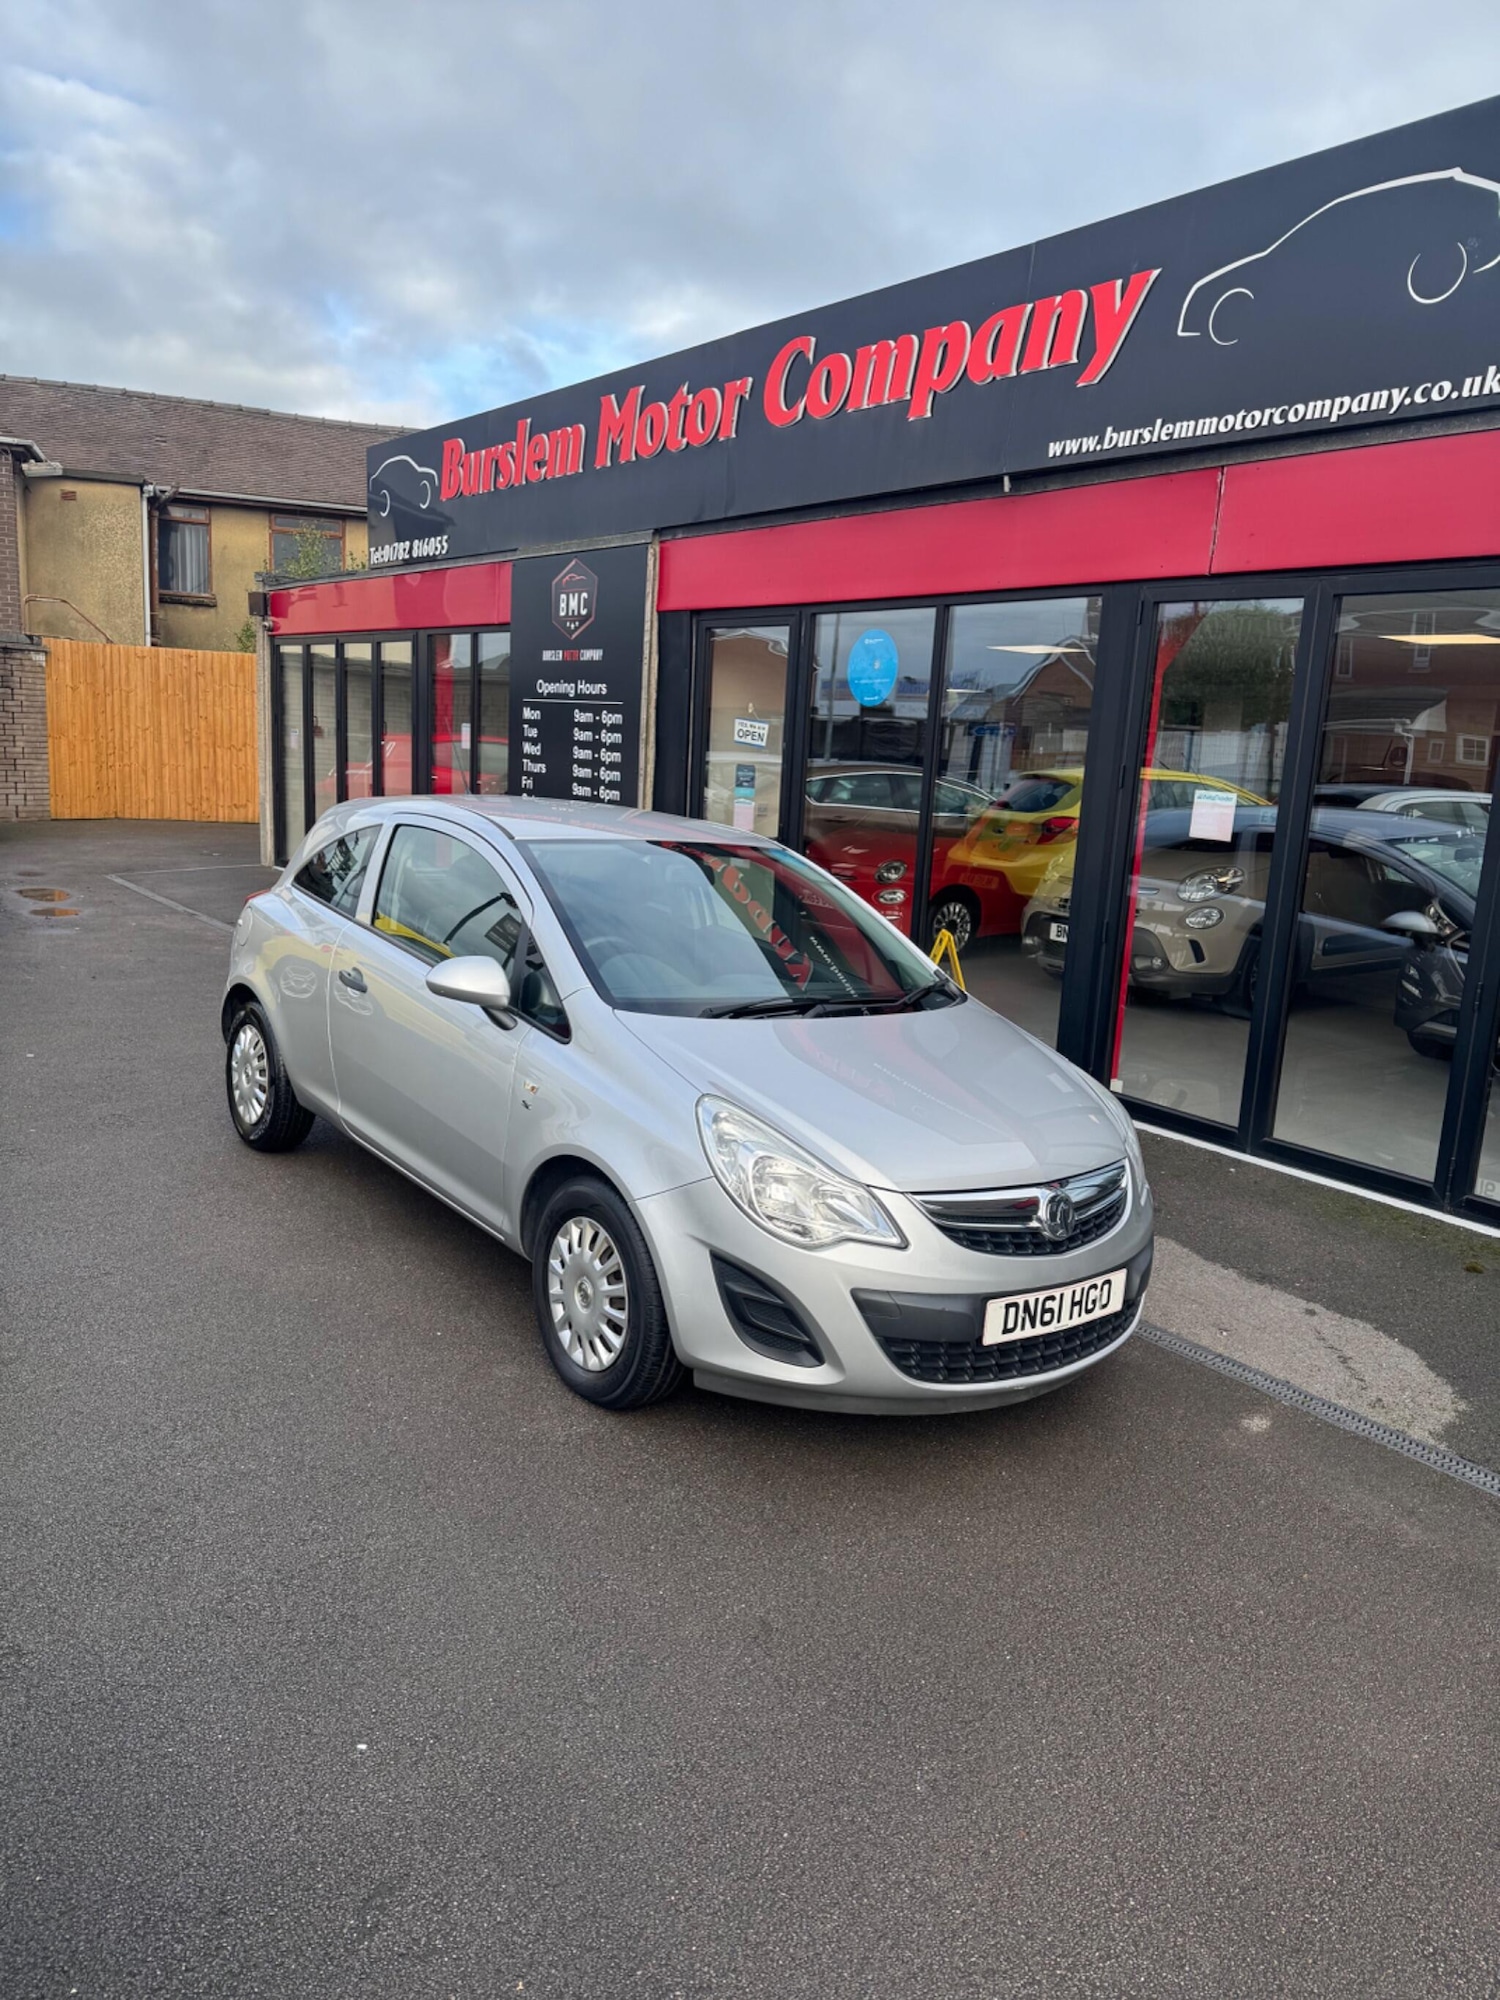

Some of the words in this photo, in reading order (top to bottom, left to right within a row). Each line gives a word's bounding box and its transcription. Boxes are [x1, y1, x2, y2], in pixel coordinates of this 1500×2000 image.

[440, 418, 585, 501] Burslem
[594, 376, 754, 469] Motor
[763, 267, 1163, 429] Company
[1047, 364, 1500, 458] www.burslemmotorcompany.co.uk
[412, 535, 448, 558] 816055
[559, 592, 588, 617] BMC
[536, 679, 576, 698] Opening
[577, 679, 608, 695] Hours
[522, 707, 541, 720] Mon
[573, 708, 594, 723] 9am
[601, 709, 623, 727] 6pm
[522, 724, 539, 738] Tue
[573, 727, 593, 742] 9am
[600, 728, 622, 746] 6pm
[737, 728, 765, 742] OPEN
[522, 741, 541, 755] Wed
[572, 745, 593, 760] 9am
[600, 747, 622, 765] 6pm
[522, 759, 546, 773] Thurs
[572, 763, 592, 778] 9am
[599, 766, 621, 784] 6pm
[521, 776, 533, 789] Fri
[571, 782, 592, 797] 9am
[598, 785, 620, 803] 6pm
[1002, 1293, 1064, 1334] DN61
[1068, 1279, 1112, 1321] HGO
